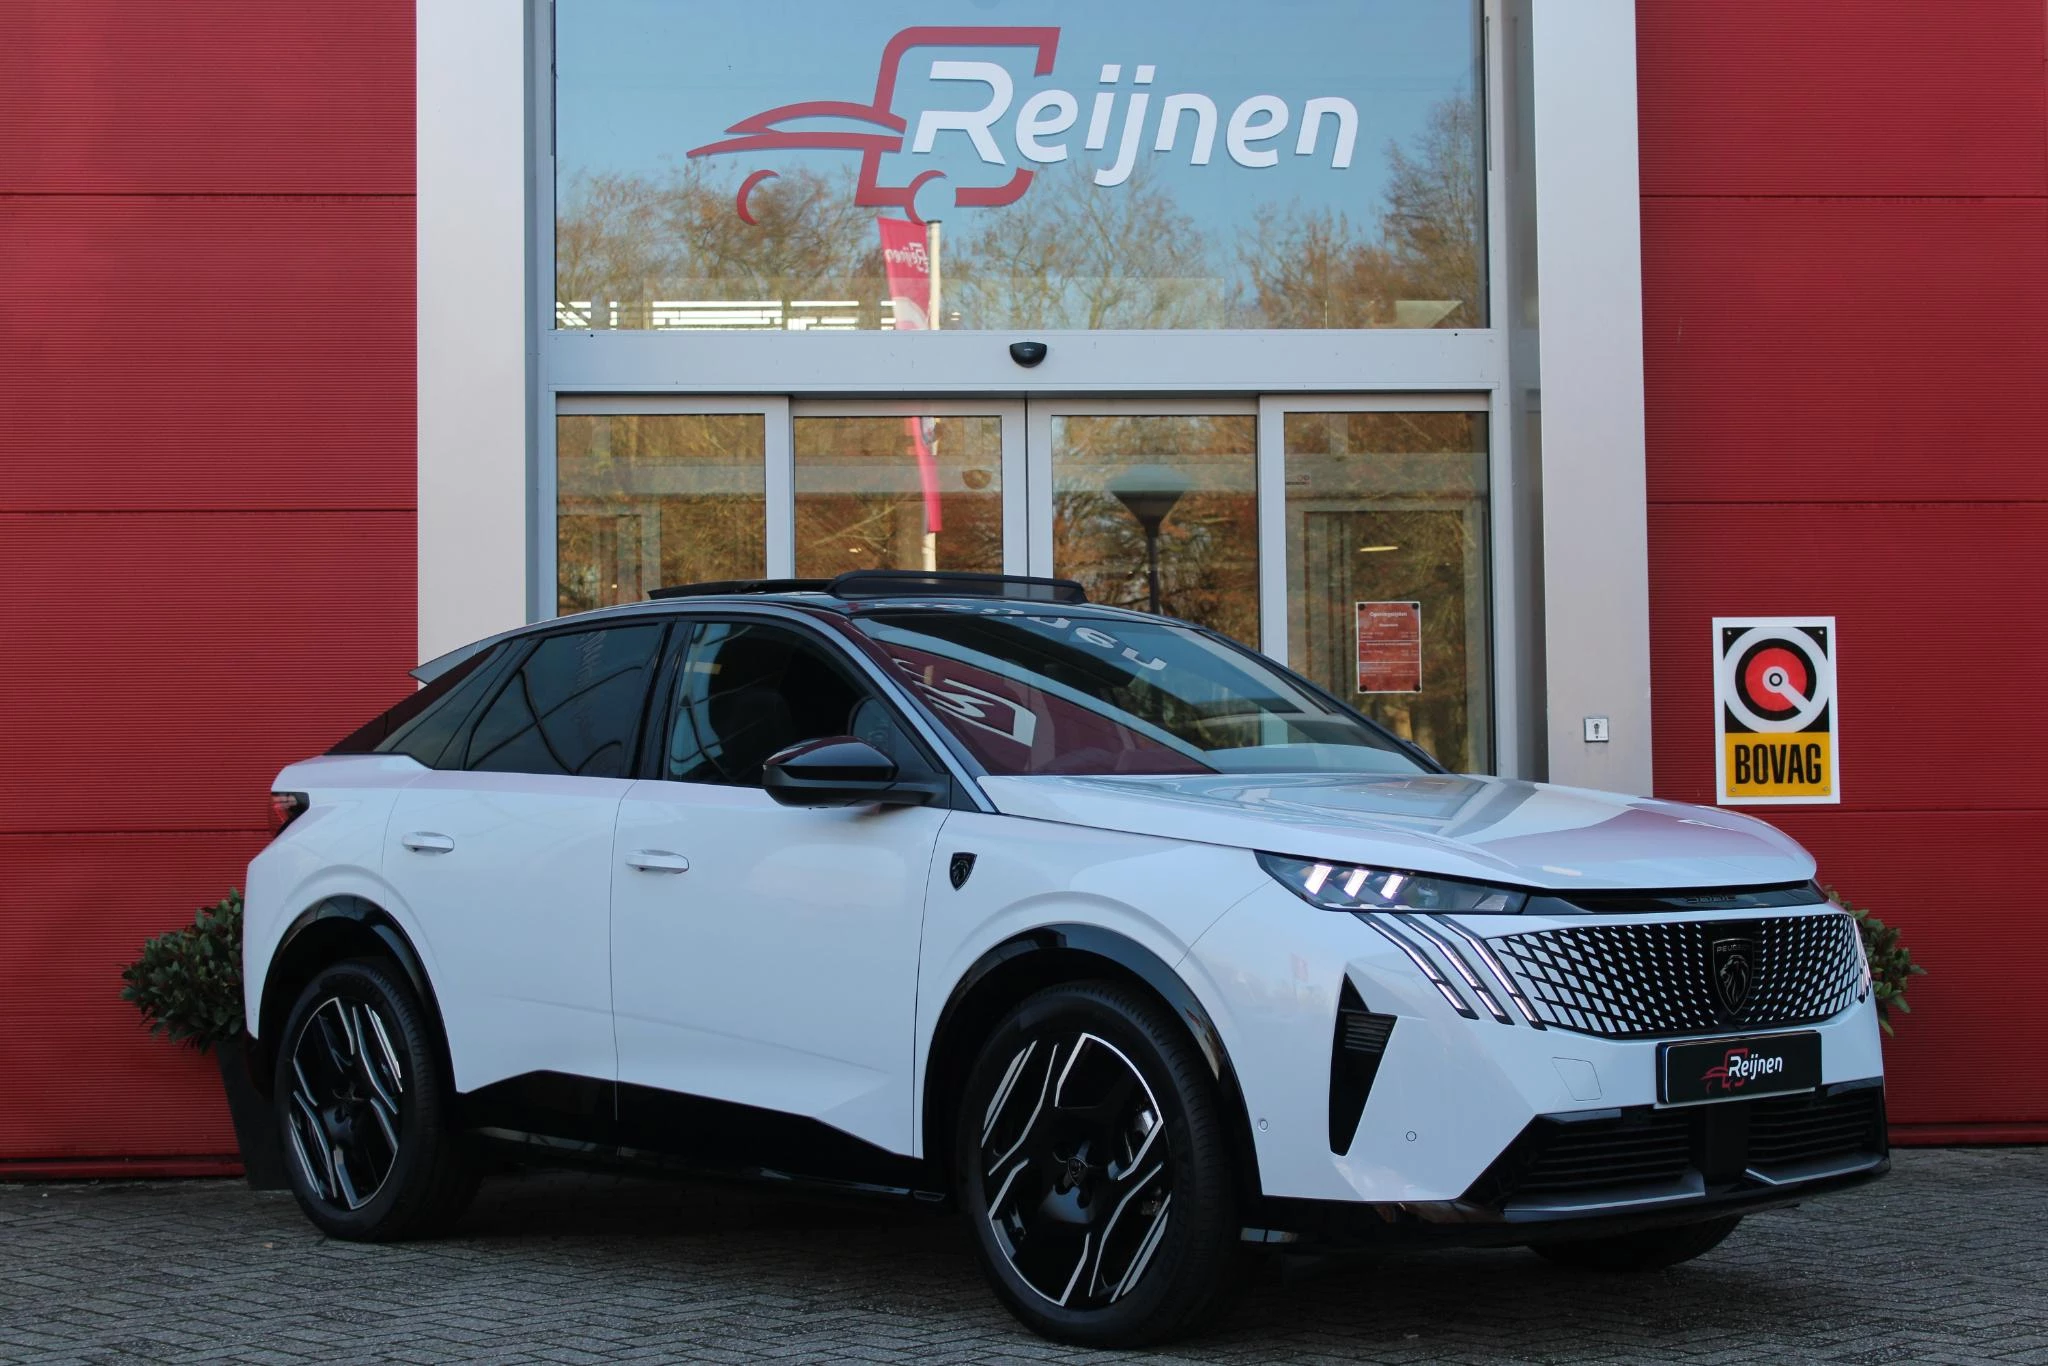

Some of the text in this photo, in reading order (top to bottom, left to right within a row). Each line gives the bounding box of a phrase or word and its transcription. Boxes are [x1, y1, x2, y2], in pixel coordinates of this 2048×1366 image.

[912, 61, 1359, 186] Reijnen
[1735, 743, 1822, 785] BOVAG
[1728, 1055, 1783, 1080] Reijnen
